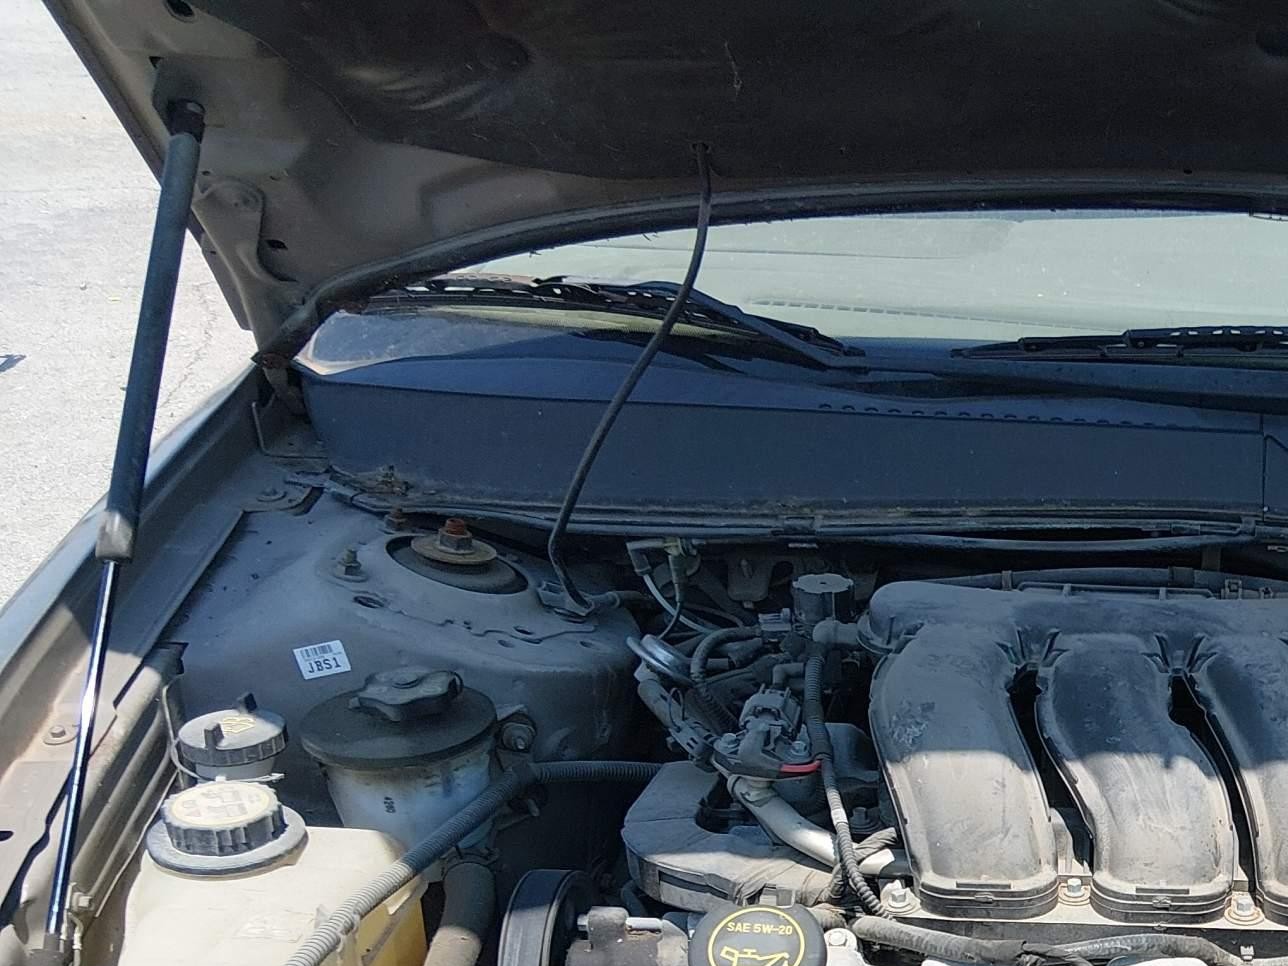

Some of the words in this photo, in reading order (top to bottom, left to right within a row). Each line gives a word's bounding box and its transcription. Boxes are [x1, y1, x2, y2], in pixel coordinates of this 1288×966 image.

[308, 657, 342, 674] JBS1
[726, 921, 752, 933] SAE
[753, 923, 793, 935] 5W-20
